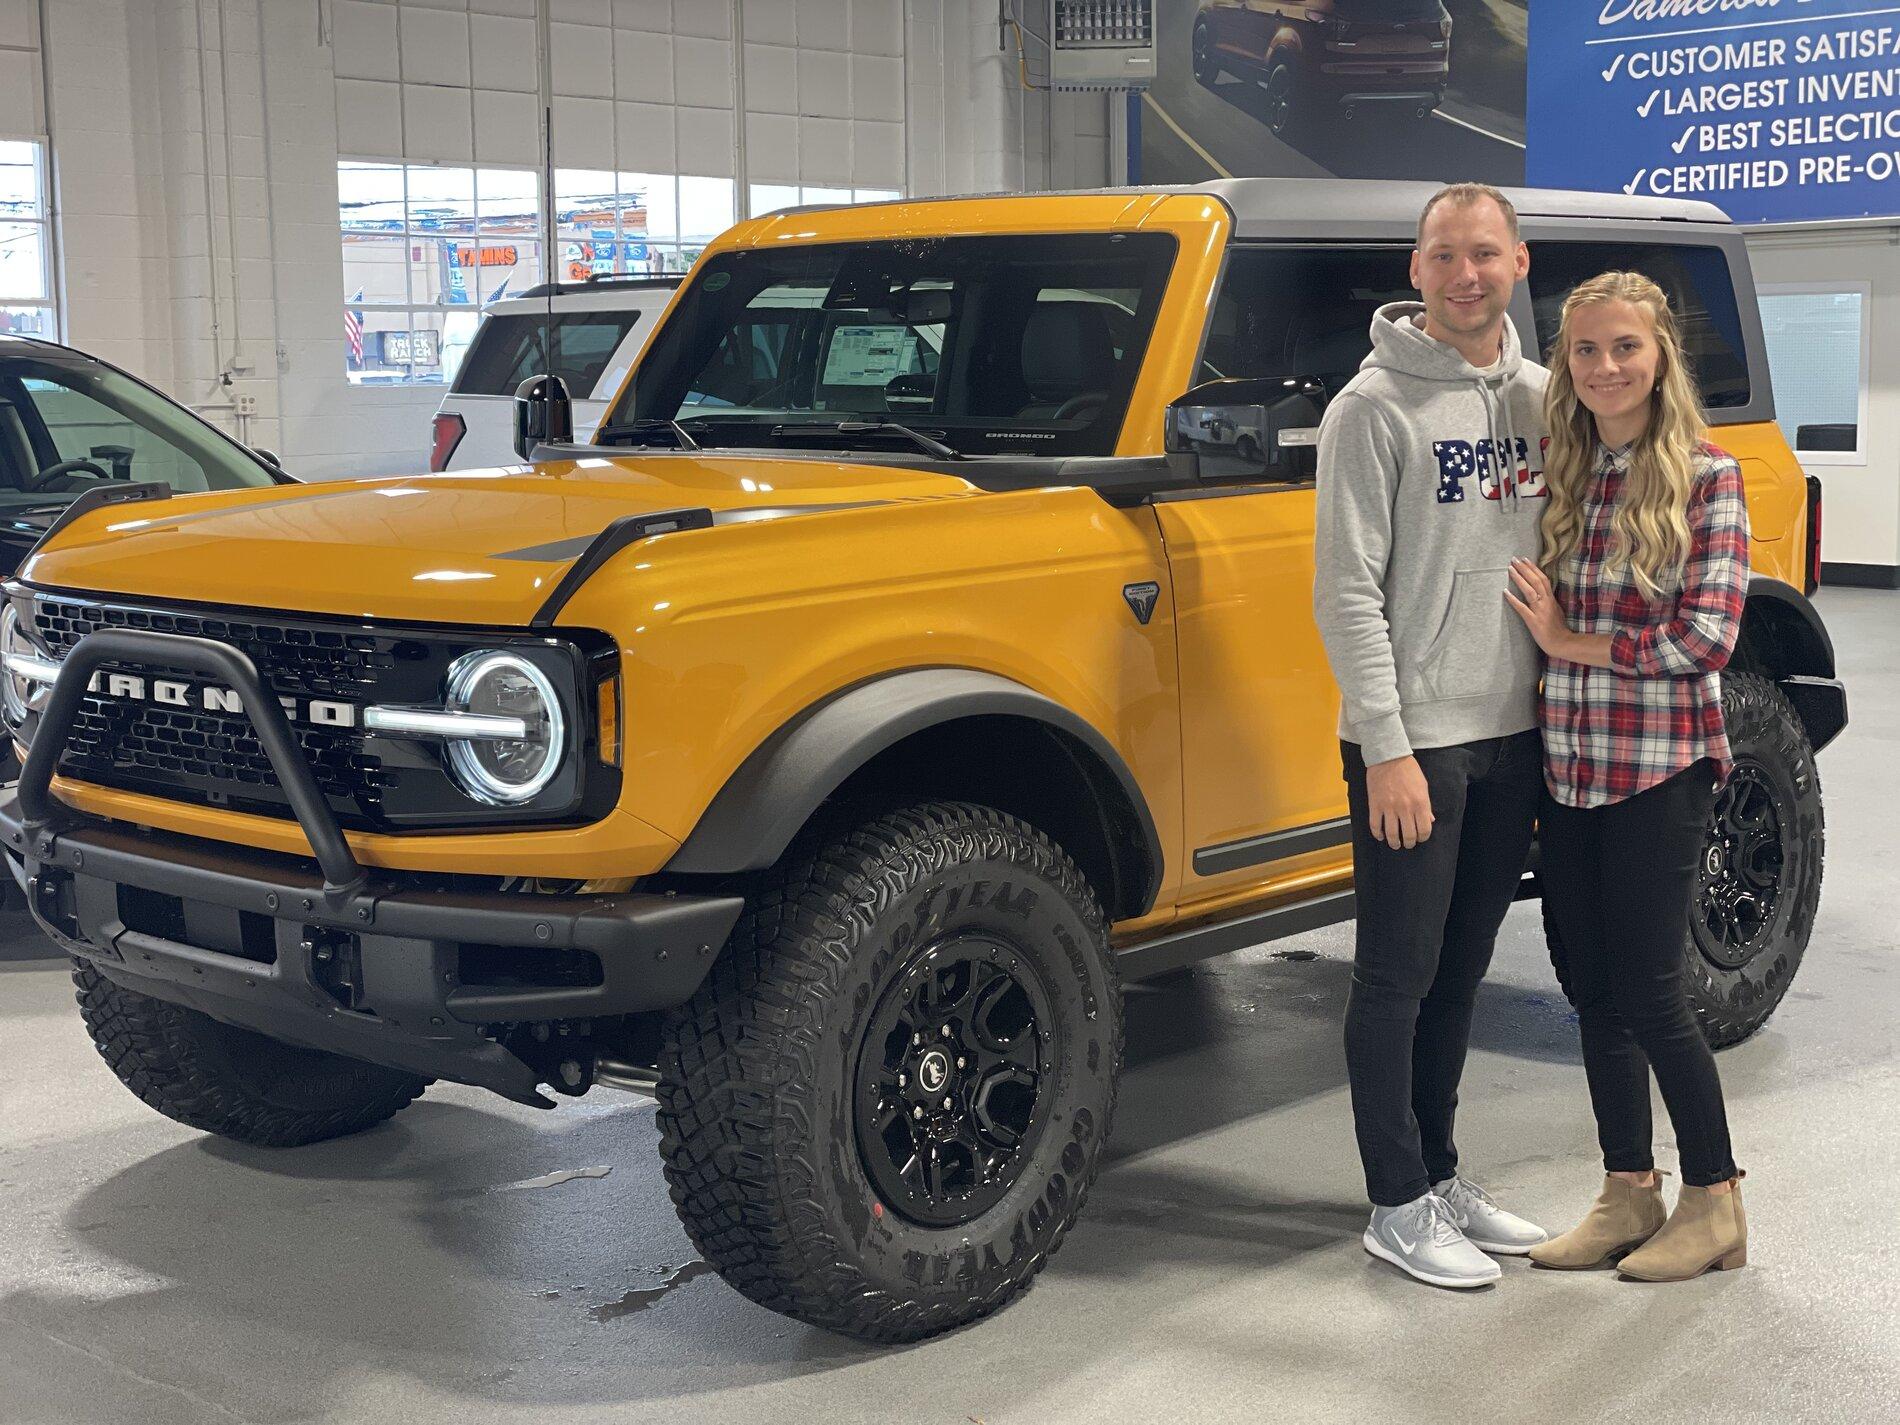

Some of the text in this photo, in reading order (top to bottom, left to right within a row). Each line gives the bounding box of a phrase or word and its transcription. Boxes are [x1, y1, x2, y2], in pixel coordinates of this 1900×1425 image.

[1627, 39, 1786, 79] CUSTOMER
[1663, 78, 1789, 115] LARGEST
[1699, 109, 1900, 152] BEST SELECTIO
[1649, 151, 1900, 194] CERTIFIED PRE-O
[456, 246, 516, 267] TAMINS
[1432, 437, 1550, 503] POL
